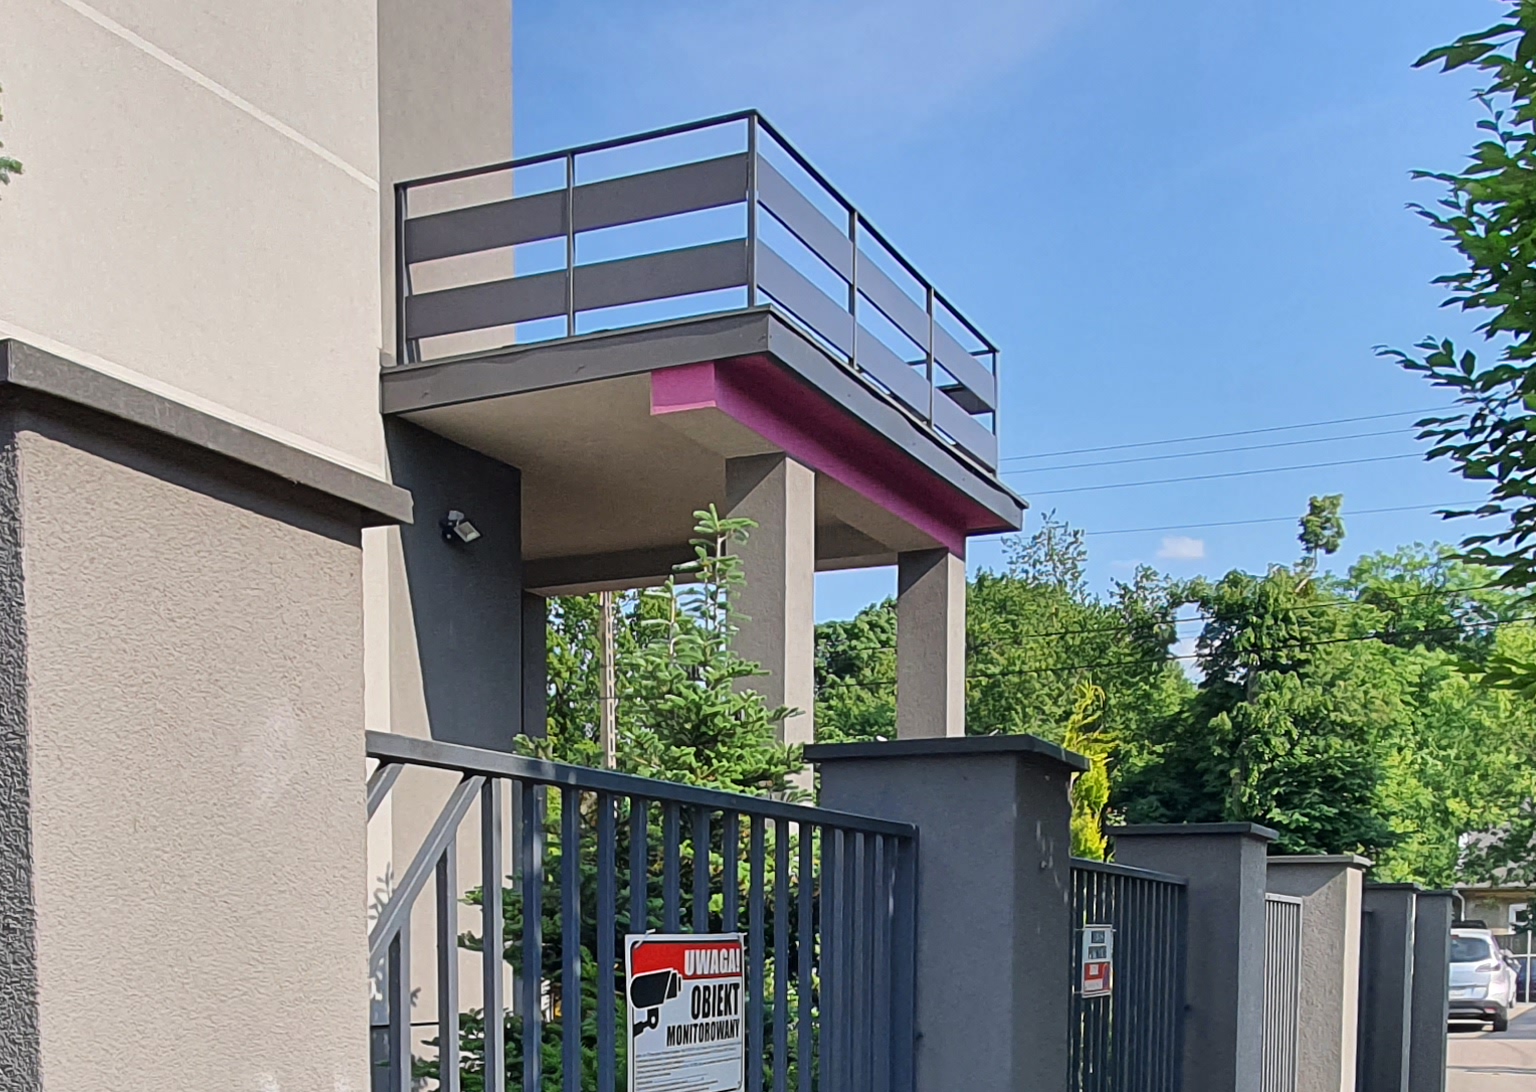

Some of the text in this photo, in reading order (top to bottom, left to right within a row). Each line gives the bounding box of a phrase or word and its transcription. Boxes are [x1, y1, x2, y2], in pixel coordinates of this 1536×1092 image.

[684, 948, 740, 976] UWAGA!
[691, 983, 740, 1020] OBIEKT
[666, 1019, 740, 1047] MONITOROWANY
